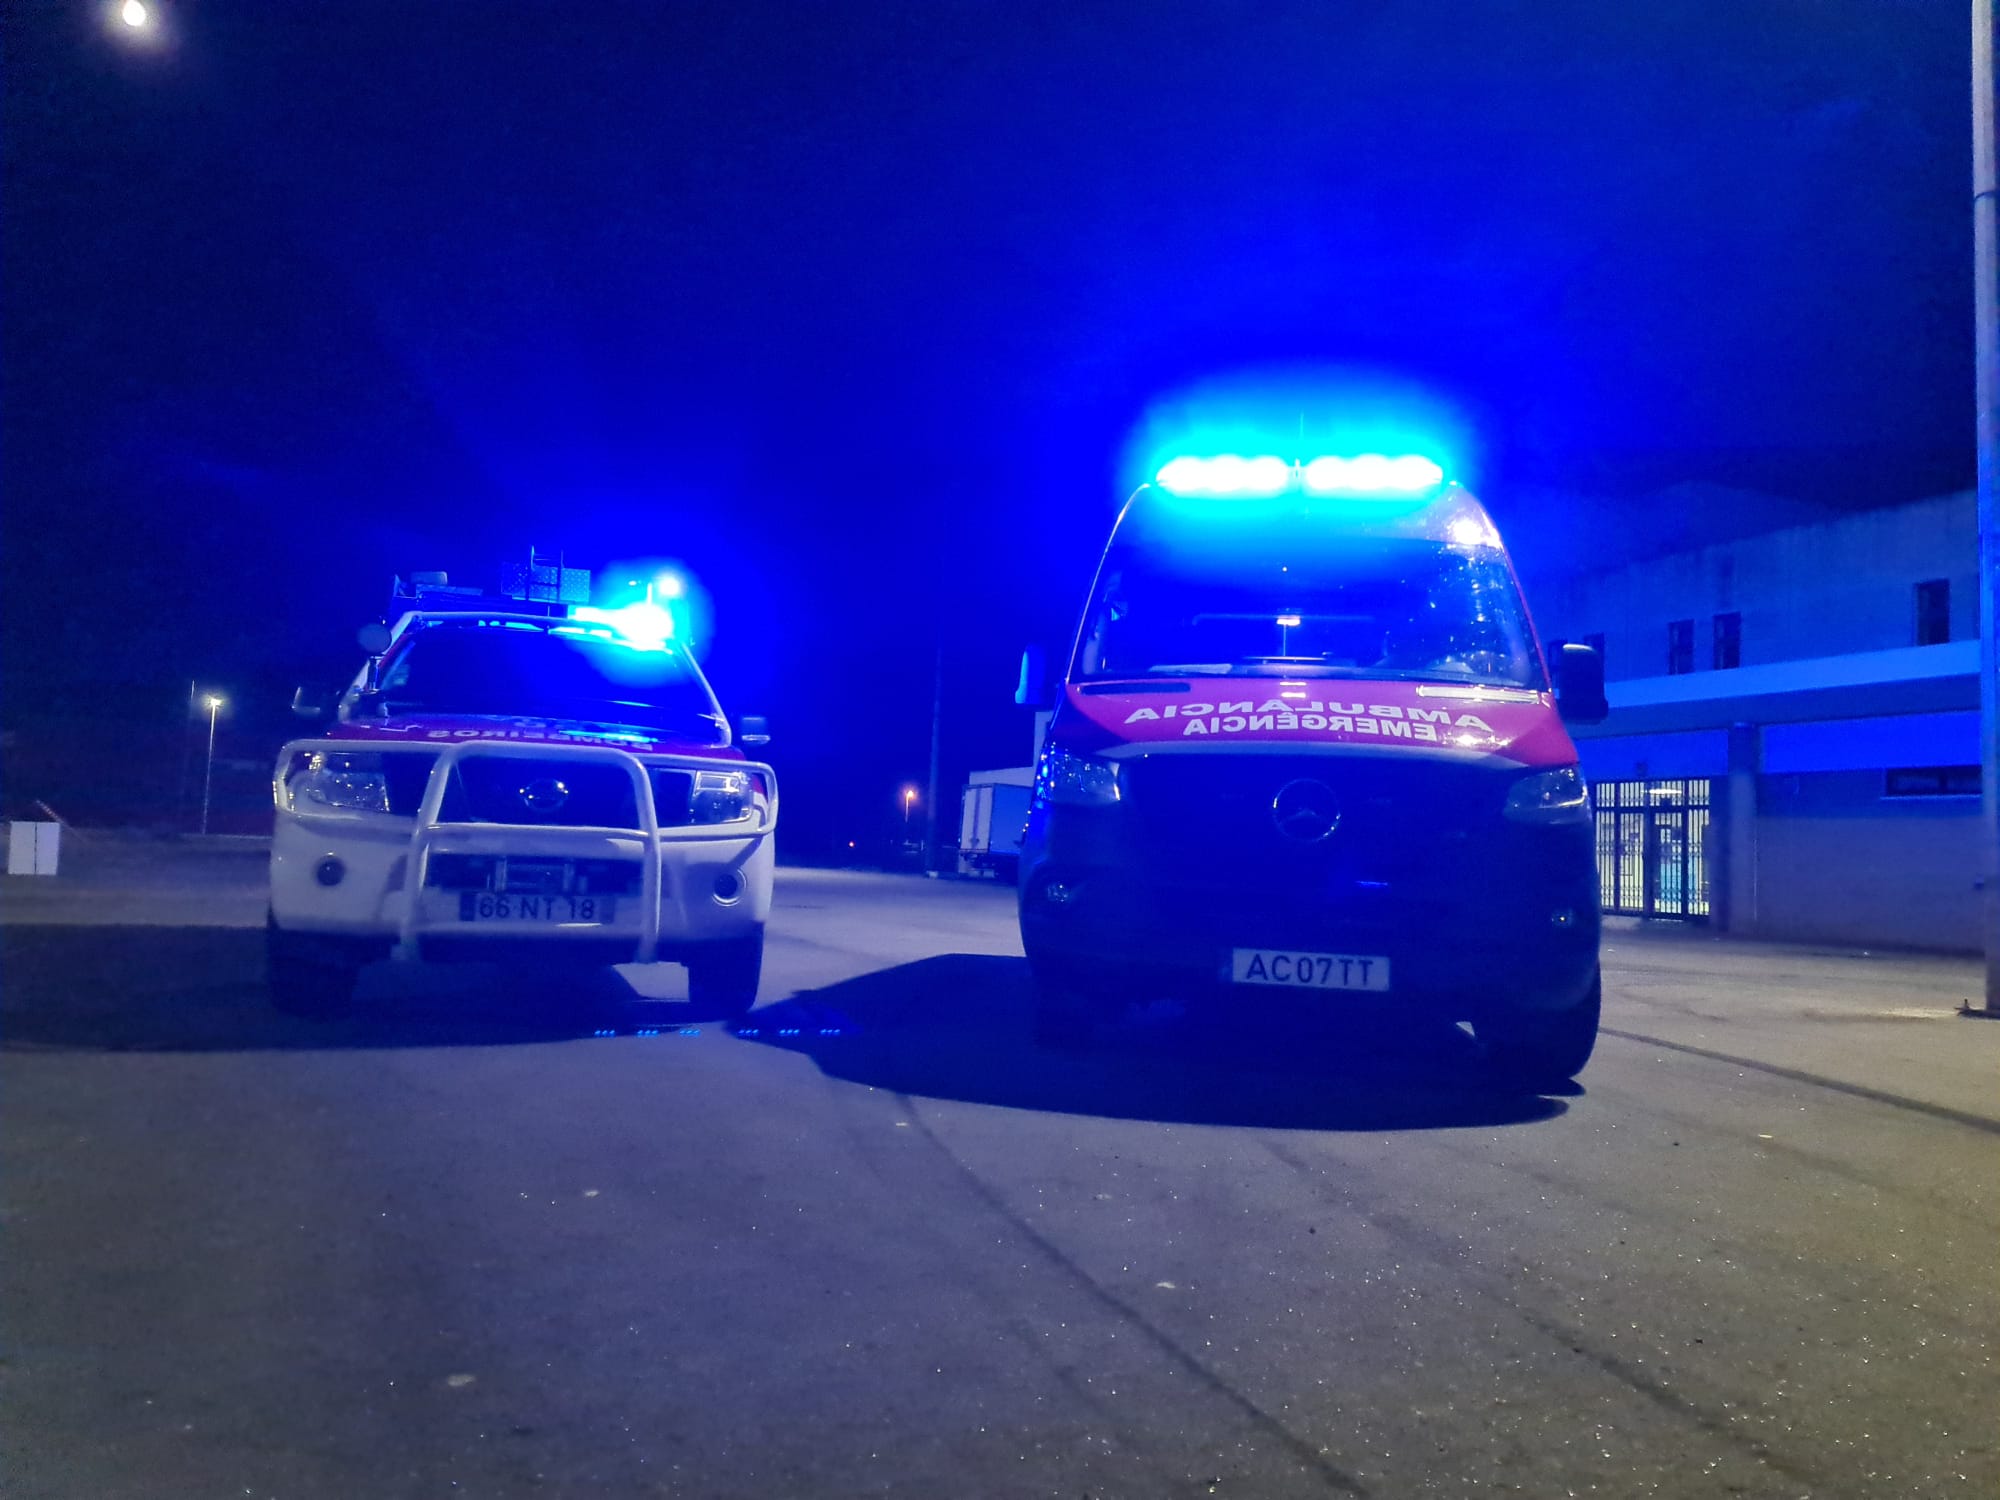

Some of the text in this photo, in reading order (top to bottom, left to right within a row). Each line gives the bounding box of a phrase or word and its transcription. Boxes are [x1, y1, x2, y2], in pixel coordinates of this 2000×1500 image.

[479, 896, 595, 920] 66 NT 18
